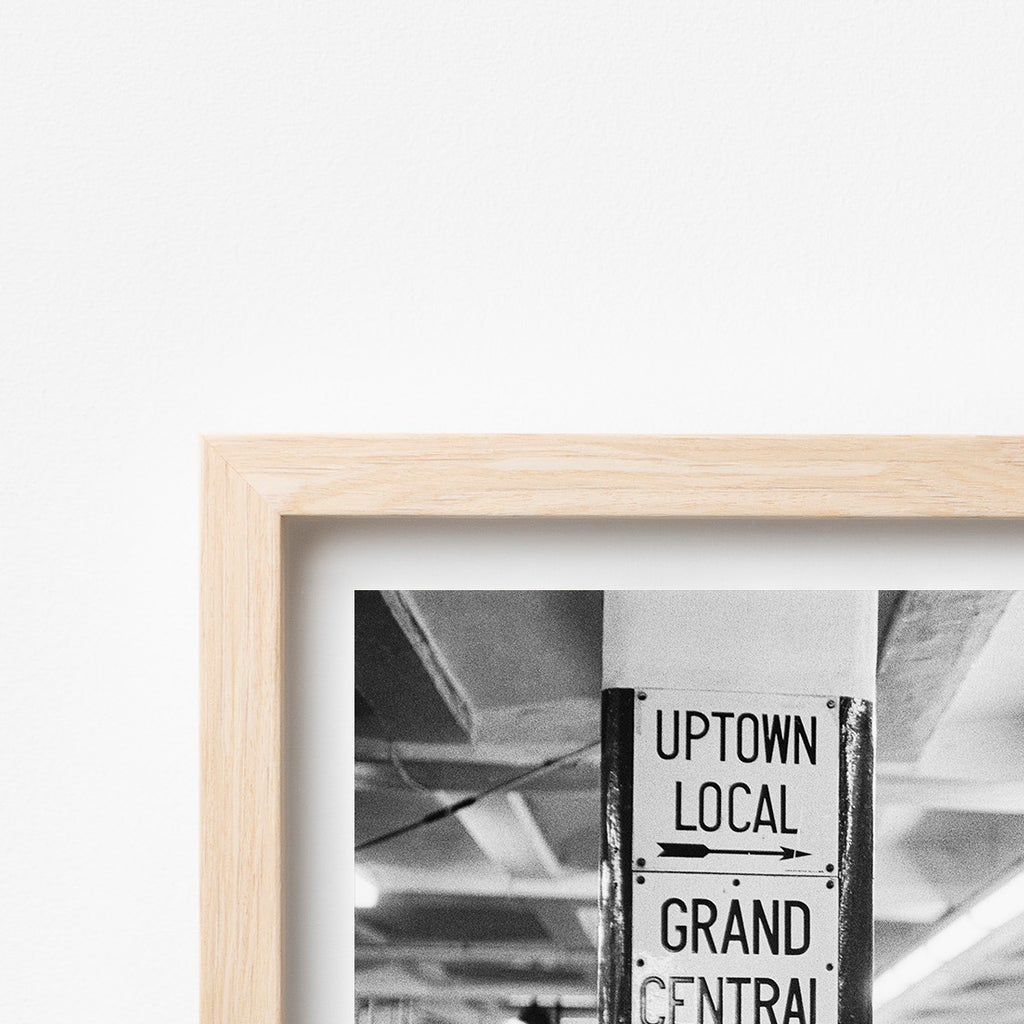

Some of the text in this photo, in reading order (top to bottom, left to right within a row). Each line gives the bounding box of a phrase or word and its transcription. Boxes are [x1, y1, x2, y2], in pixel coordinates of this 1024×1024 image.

[656, 709, 817, 765] UPTOWN
[675, 780, 798, 834] LOCAL
[660, 897, 811, 956] GRAND
